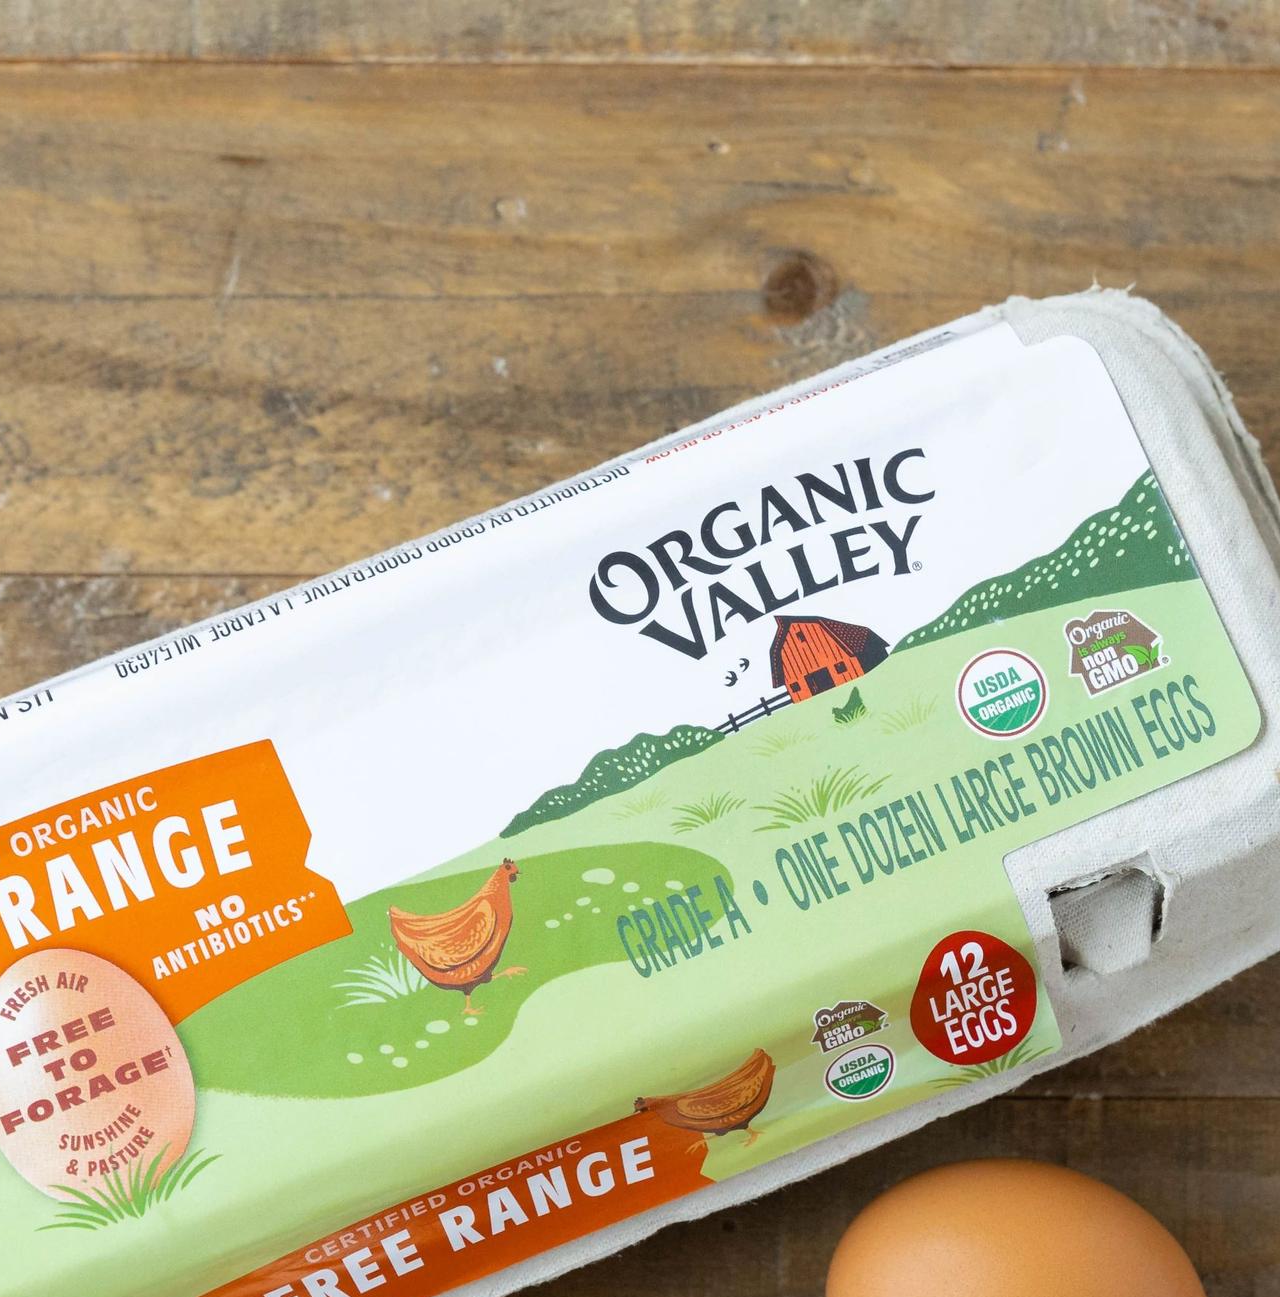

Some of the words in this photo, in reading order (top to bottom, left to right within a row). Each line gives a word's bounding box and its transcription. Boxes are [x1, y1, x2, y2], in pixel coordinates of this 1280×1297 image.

[589, 448, 935, 624] ORGANIC
[1069, 610, 1130, 644] Organic
[1082, 647, 1117, 670] non
[1089, 654, 1138, 689] GMO
[974, 667, 1022, 697] USDA
[979, 688, 1035, 720] ORGANIC
[10, 787, 157, 856] ORGANIC
[617, 889, 731, 980] GRADE
[715, 868, 755, 946] A
[775, 832, 850, 910] ONE
[837, 791, 947, 884] DOZEN
[934, 753, 1037, 844] LARGE
[1024, 707, 1144, 805] BROWN
[1131, 675, 1216, 759] EGGS
[195, 895, 245, 931] NO
[940, 942, 988, 985] 12
[0, 975, 50, 1019] FRESH
[57, 971, 88, 992] AIR
[818, 1001, 865, 1026] Organic
[930, 968, 1014, 1022] LARGE
[7, 1007, 117, 1065] FREE
[823, 1024, 850, 1039] non
[826, 1026, 867, 1048] GMO
[944, 999, 1017, 1055] EGGS
[44, 1048, 97, 1079] TO
[839, 1063, 885, 1087] ORGANIC
[840, 1053, 876, 1073] USDA
[60, 1103, 141, 1150] SUNSHINE
[66, 1160, 77, 1175] &
[88, 1126, 155, 1176] PASTURE
[305, 1194, 445, 1264] CERTIFIED
[458, 1141, 581, 1196] ORGANIC
[439, 1136, 654, 1251] RANGE
